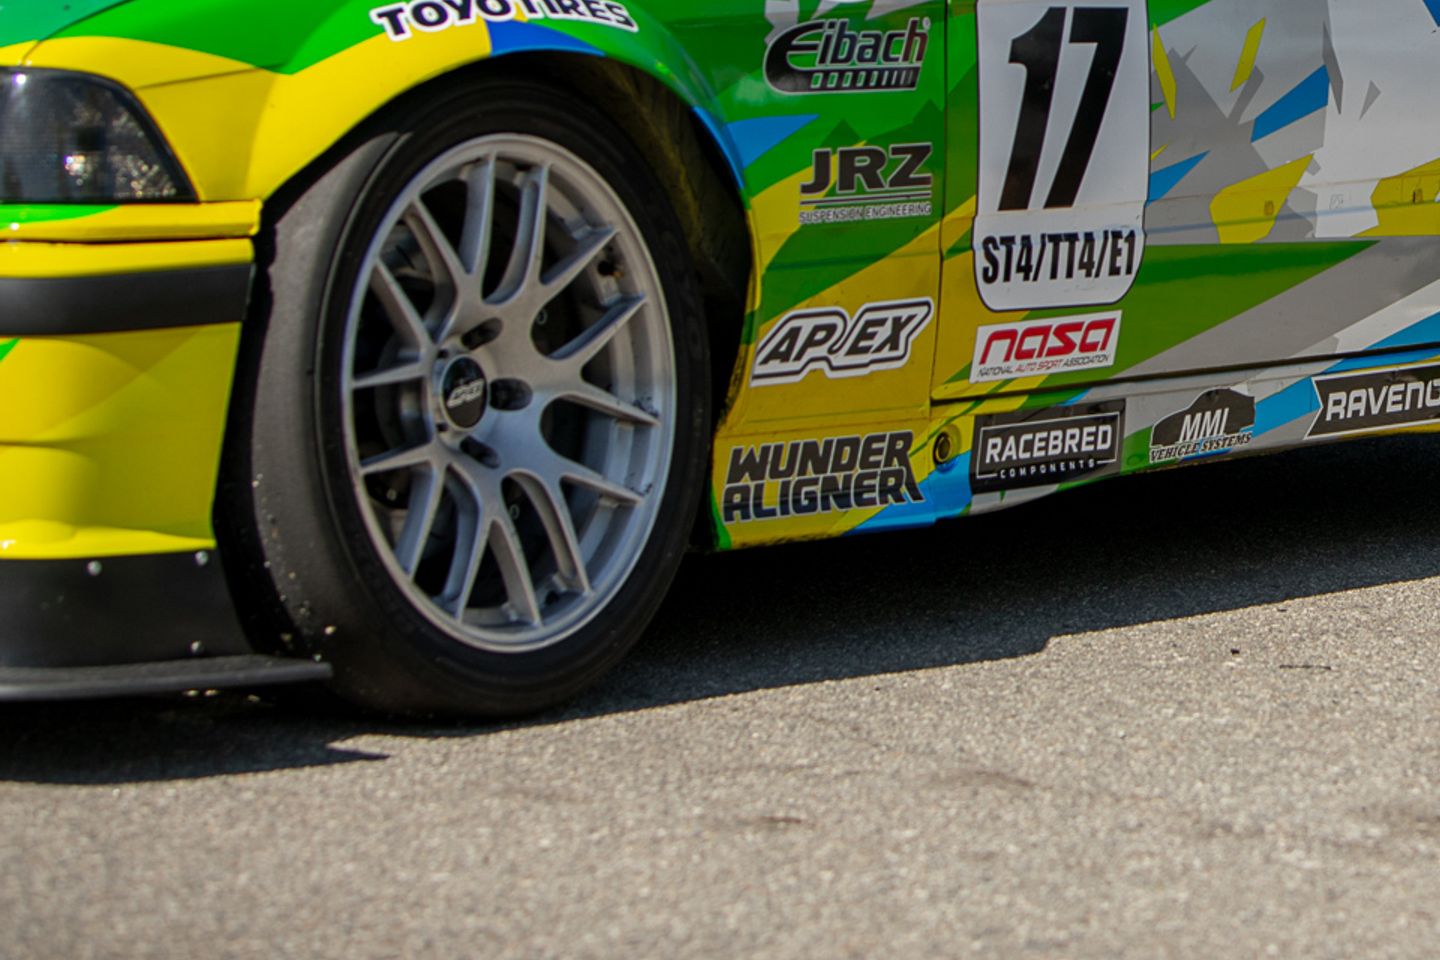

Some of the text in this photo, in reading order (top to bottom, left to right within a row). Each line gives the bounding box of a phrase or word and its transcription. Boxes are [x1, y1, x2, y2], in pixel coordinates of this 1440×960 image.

[764, 16, 929, 94] Eibach
[998, 6, 1130, 212] 17
[800, 142, 933, 195] JRZ
[799, 202, 932, 224] SUSPENSION ENGINEERING
[981, 229, 1137, 284] ST4/TT4/E1
[977, 355, 1110, 378] NATIONAL AUTO SPORT ASSOCIATION
[985, 424, 1113, 464] RACEBRED
[1150, 431, 1253, 464] VEHICLE SYSTEMS
[1178, 407, 1230, 443] MMI
[726, 430, 915, 484] WUNDER
[1000, 458, 1095, 479] COMPONENTS
[723, 466, 926, 524] ALIGNER
